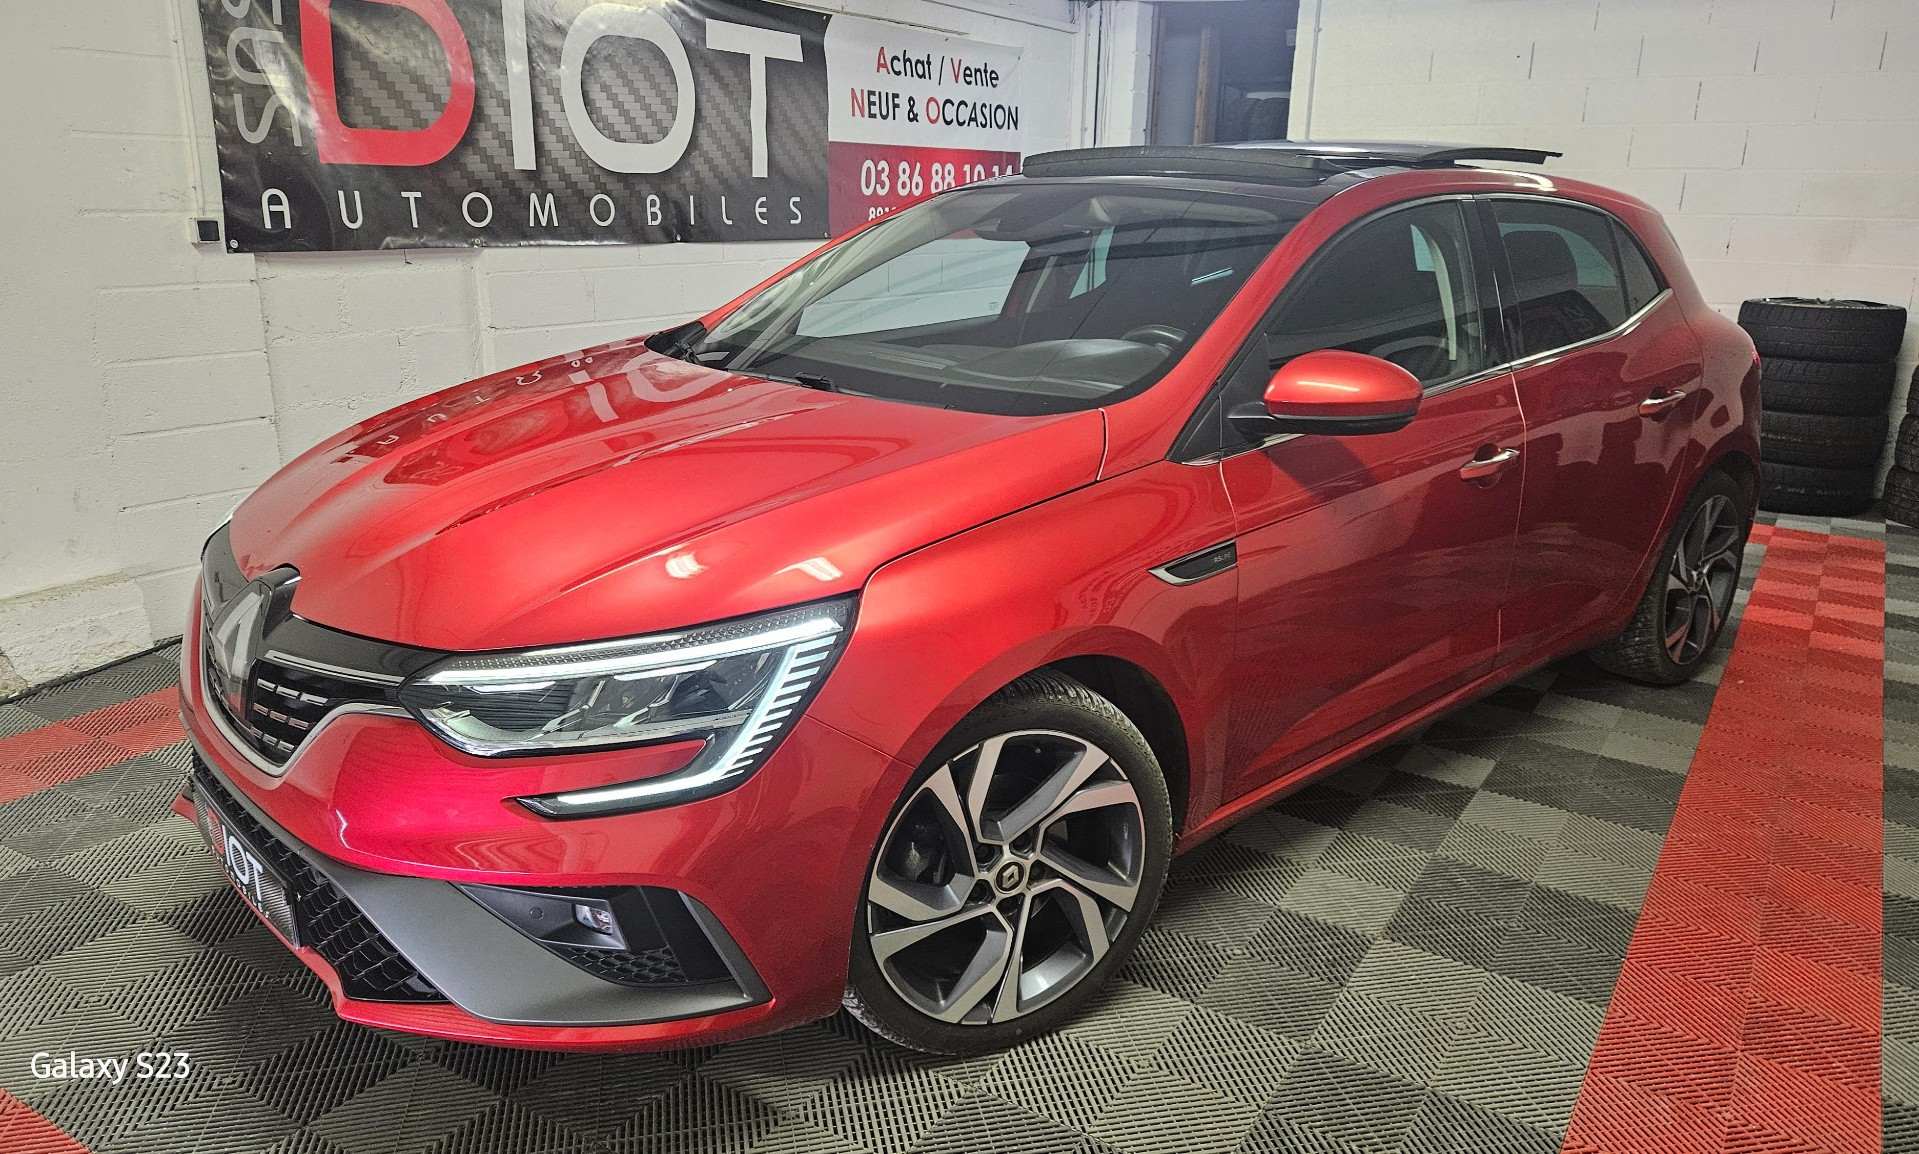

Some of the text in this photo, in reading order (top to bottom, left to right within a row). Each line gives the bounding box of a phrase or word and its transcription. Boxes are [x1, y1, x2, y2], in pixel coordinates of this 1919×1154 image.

[876, 46, 999, 88] Achat / Vente
[298, 0, 804, 178] DIOT
[850, 87, 1019, 131] NEUF & OCCASION
[860, 159, 891, 196] 03
[897, 160, 924, 197] 86
[930, 162, 956, 194] 88
[260, 188, 803, 230] AUTOMOBILES
[207, 806, 264, 902] DIOT
